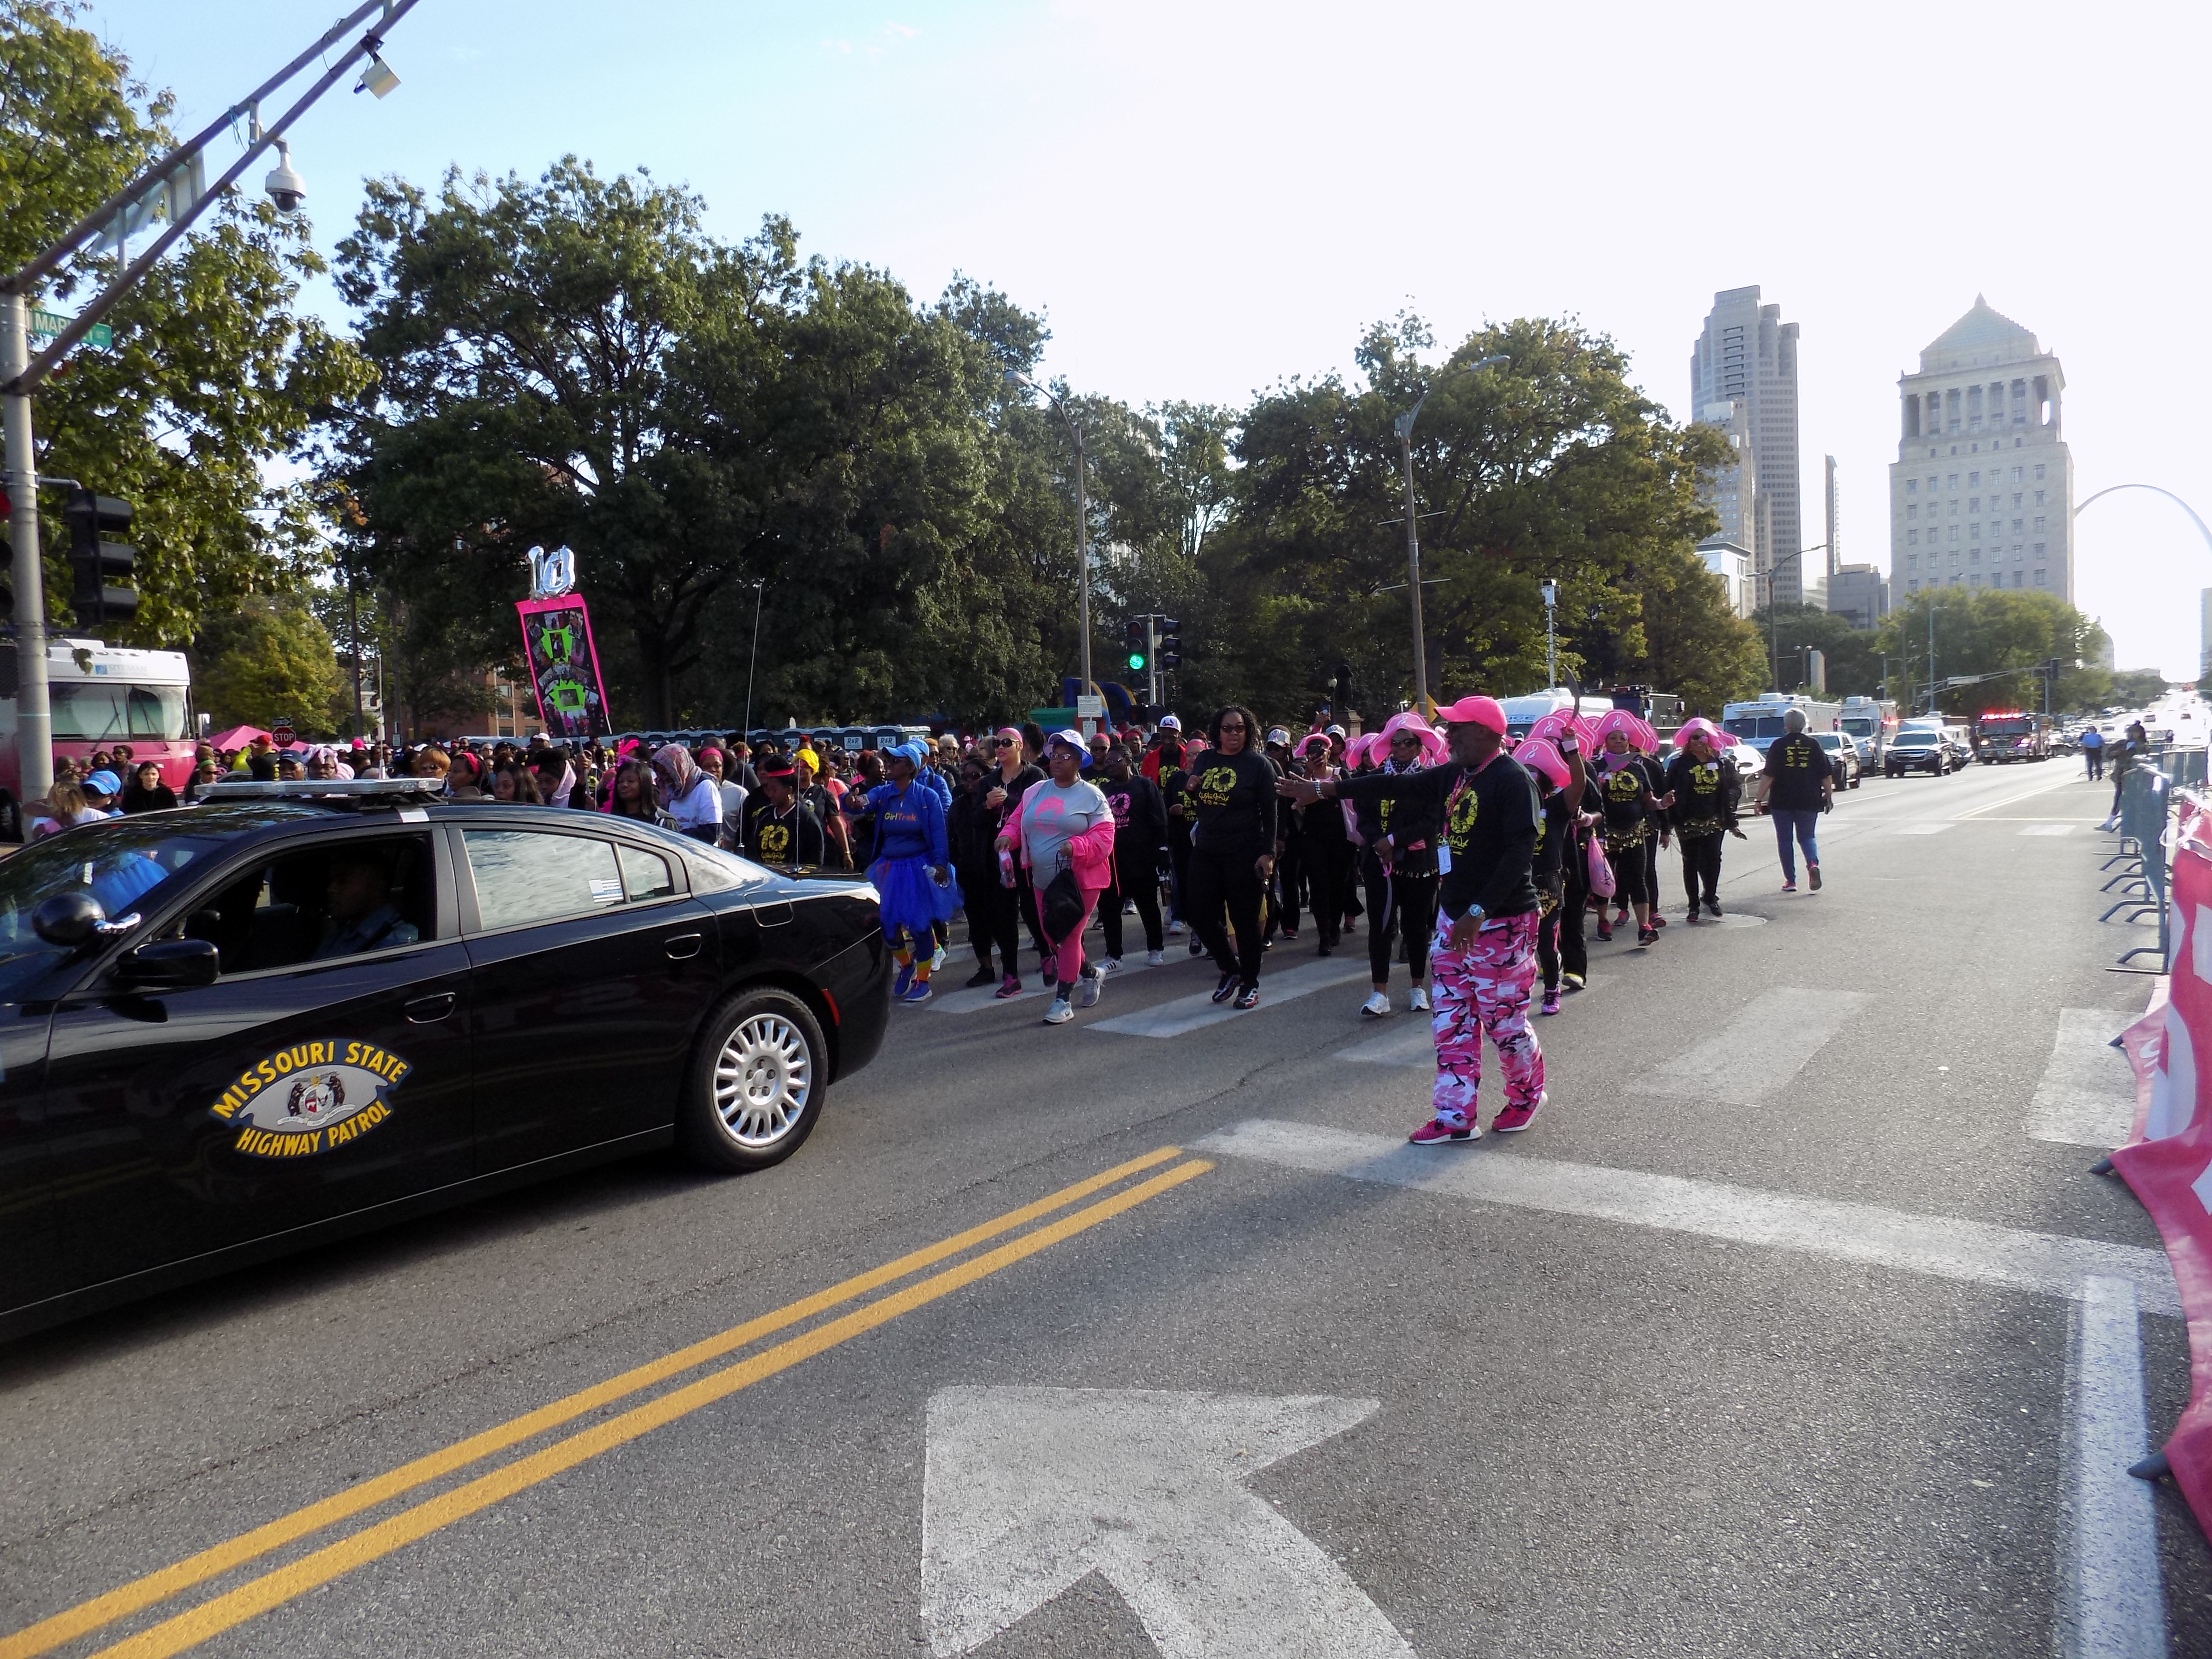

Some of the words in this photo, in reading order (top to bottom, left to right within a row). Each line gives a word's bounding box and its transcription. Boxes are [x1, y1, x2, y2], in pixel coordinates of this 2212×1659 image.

[274, 733, 294, 741] STOP
[1202, 767, 1237, 792] 10
[884, 812, 916, 821] GirlTrek
[759, 825, 789, 851] 10
[212, 1041, 334, 1119] MISSOURI
[345, 1042, 407, 1083] STATE
[235, 1127, 322, 1157] HIGHWAY
[328, 1100, 392, 1148] PATROL
